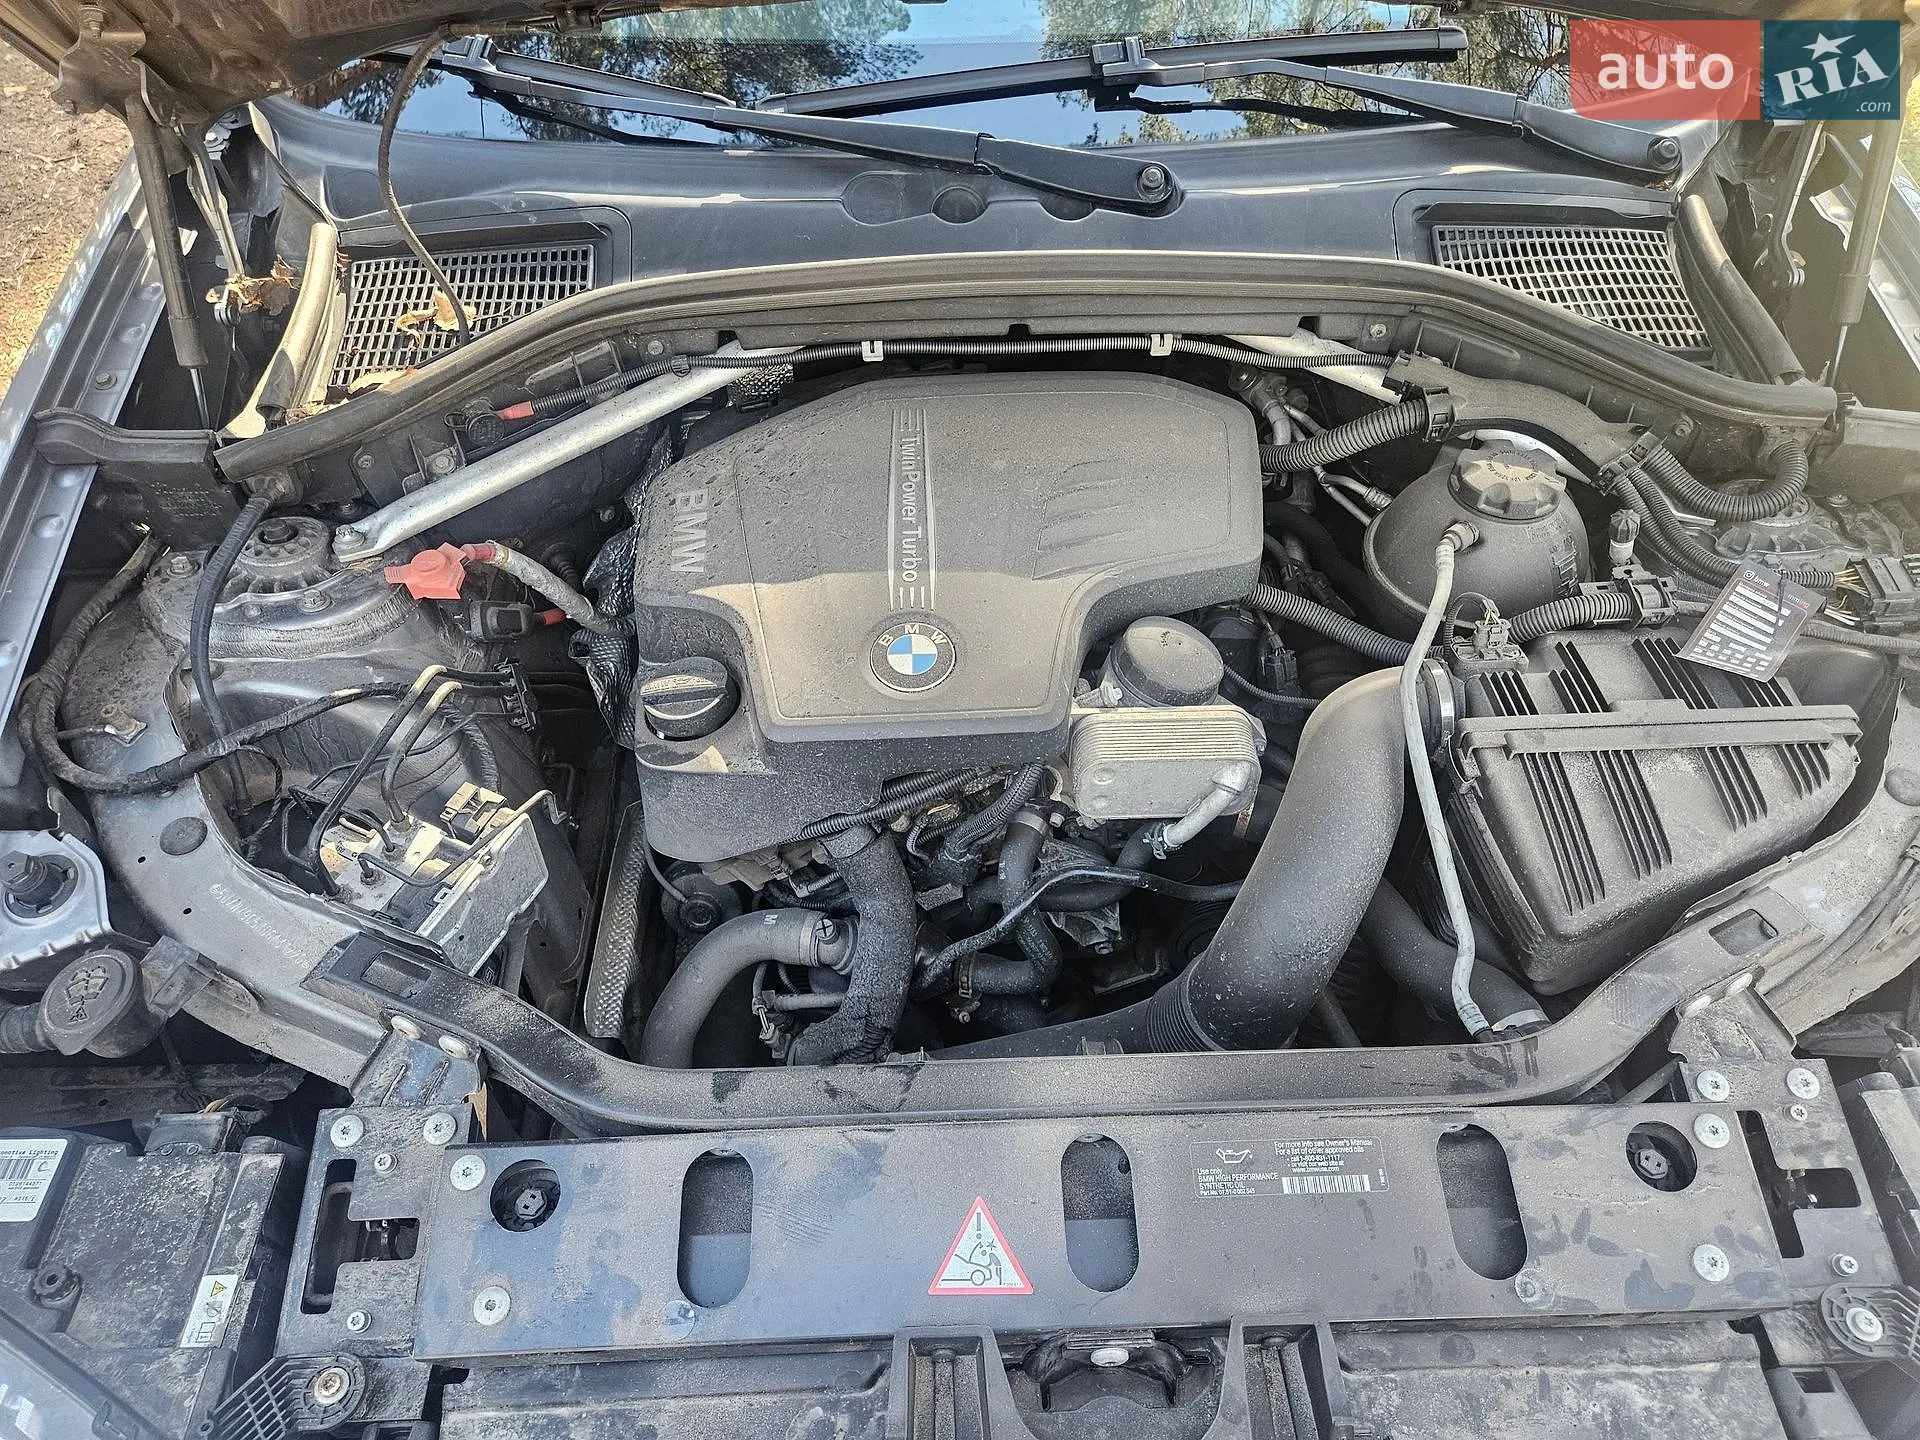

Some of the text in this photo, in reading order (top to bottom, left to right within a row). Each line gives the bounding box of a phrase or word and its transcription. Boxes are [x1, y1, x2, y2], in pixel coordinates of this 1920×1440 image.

[671, 489, 710, 572] BMW
[901, 437, 922, 582] TwinPower Turbo
[877, 624, 947, 646] BMW
[1232, 1172, 1279, 1181] PERFORMANCE
